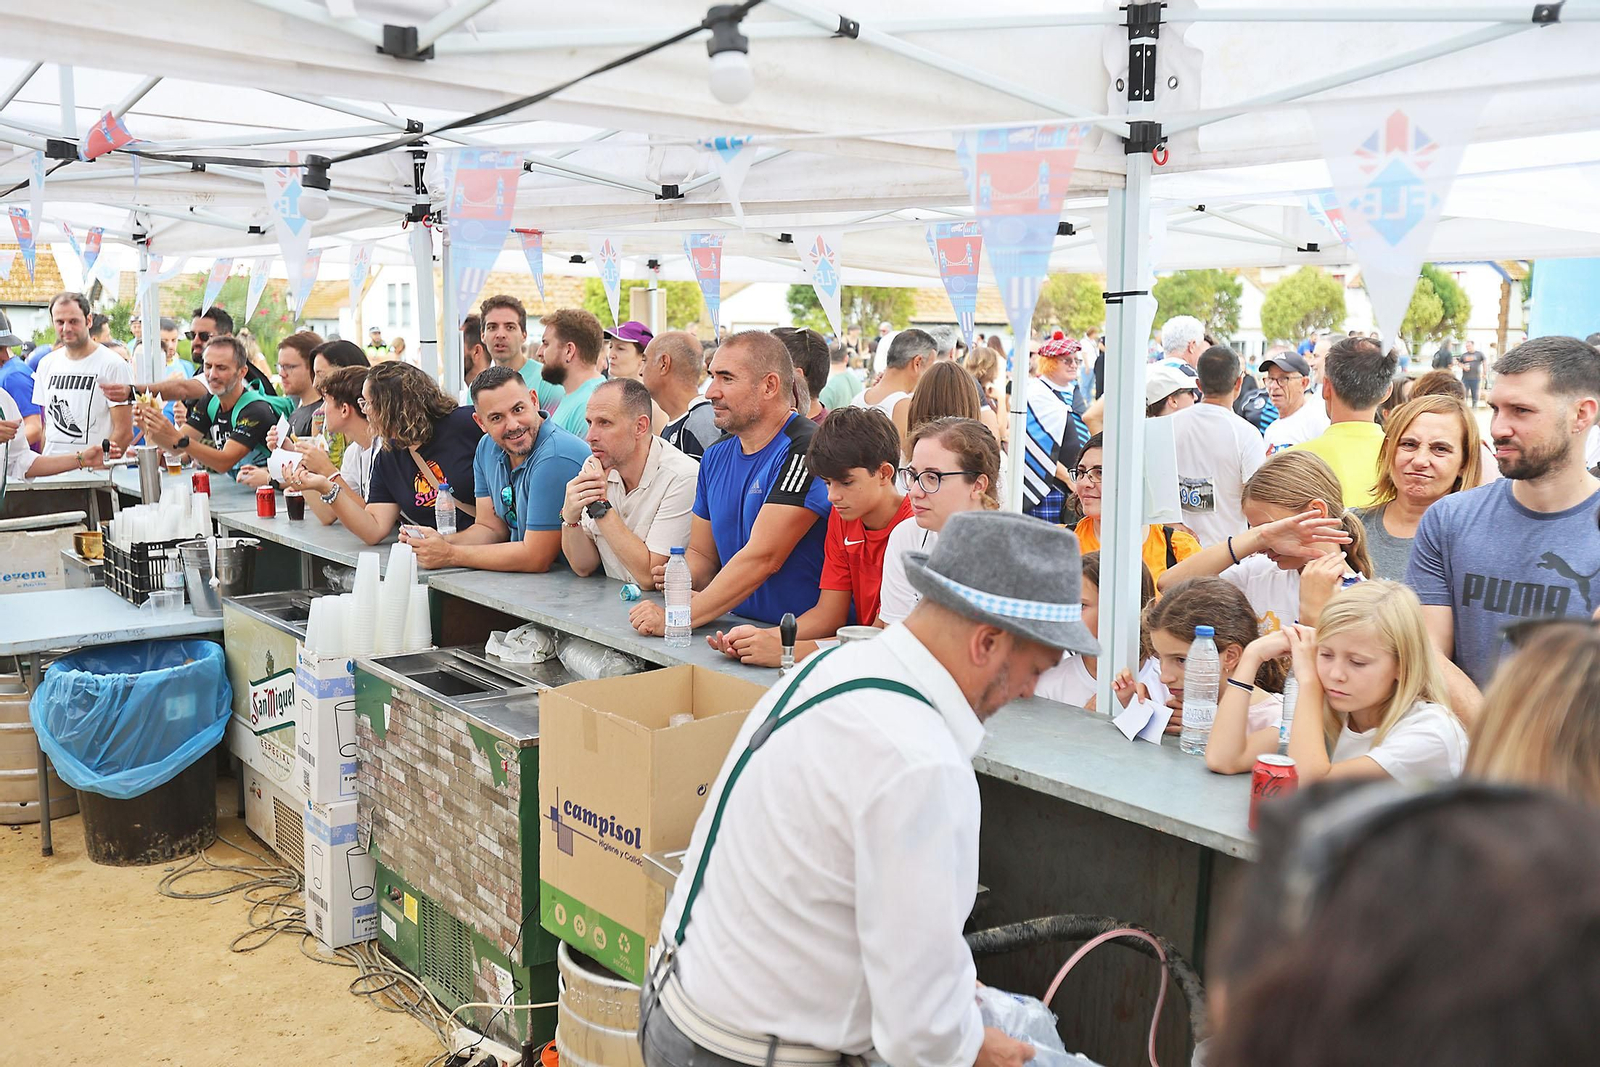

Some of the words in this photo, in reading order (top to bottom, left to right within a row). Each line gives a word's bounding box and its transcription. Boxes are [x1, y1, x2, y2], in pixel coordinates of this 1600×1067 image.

[0, 569, 46, 583] evera
[1462, 573, 1571, 617] PUMA
[251, 691, 268, 726] San
[264, 681, 295, 718] Miguel
[260, 739, 291, 765] ESPECIAL
[563, 800, 642, 850] campisol
[598, 839, 620, 857] Higiene
